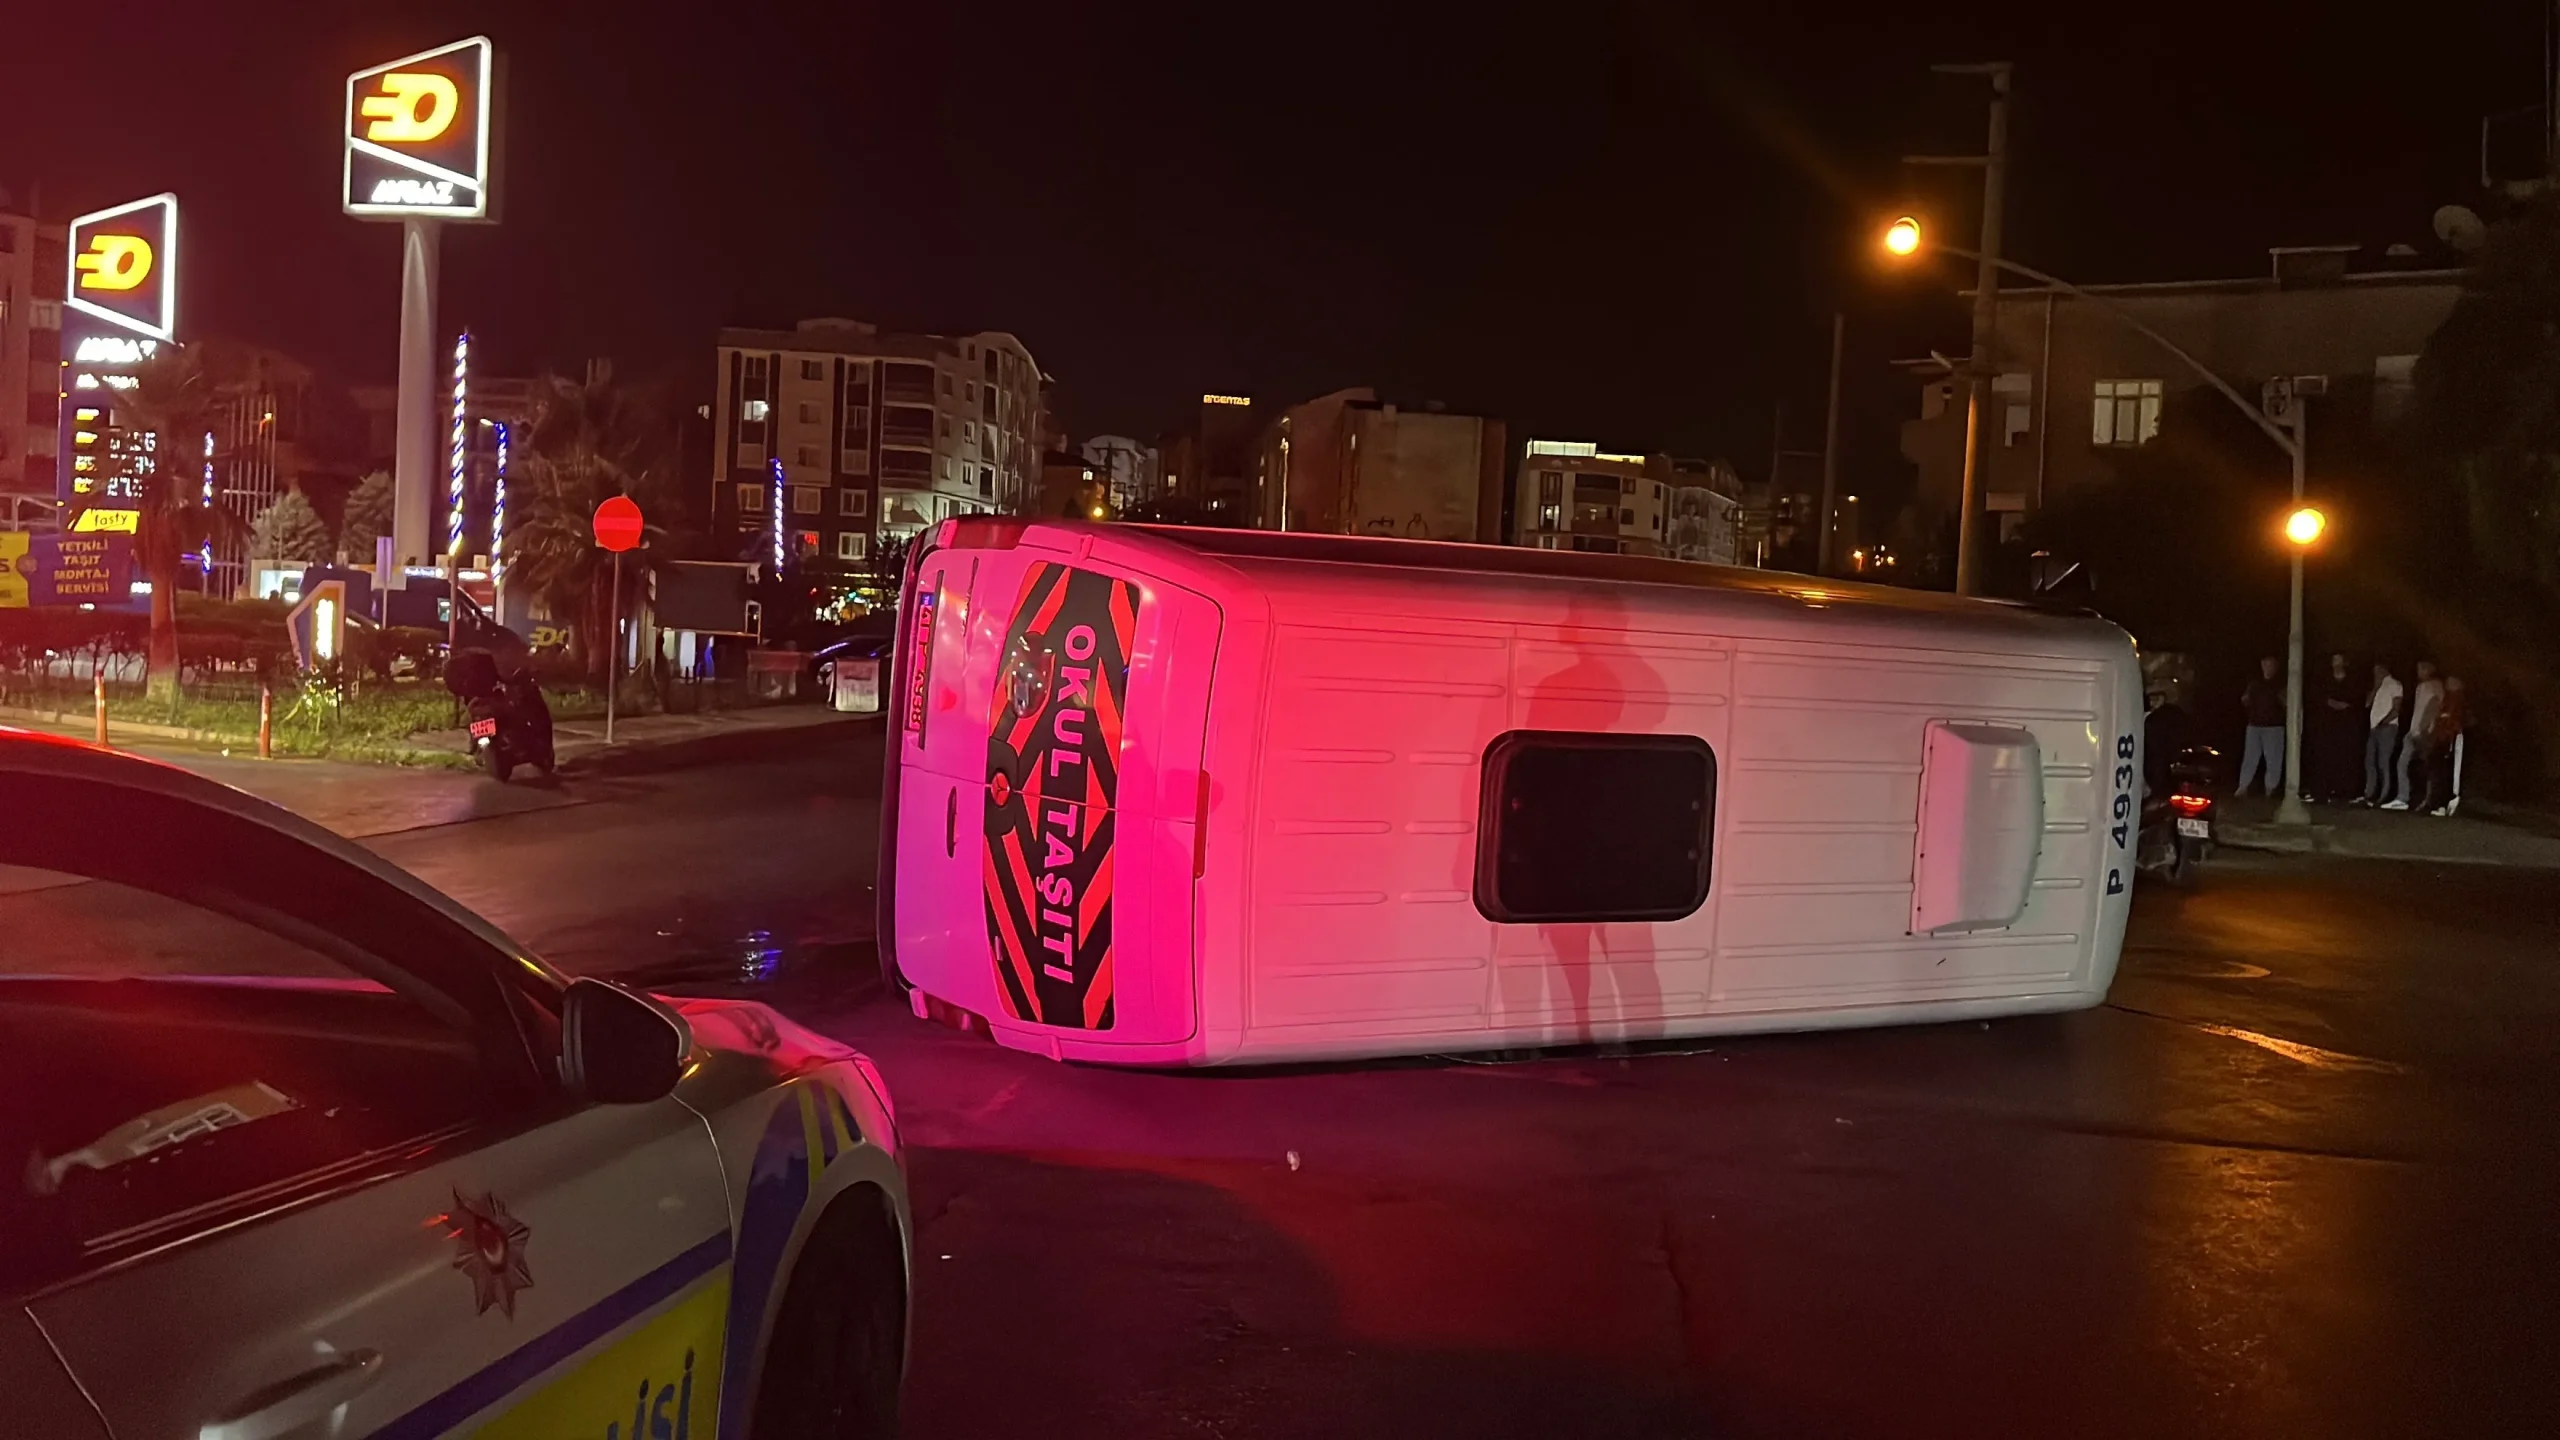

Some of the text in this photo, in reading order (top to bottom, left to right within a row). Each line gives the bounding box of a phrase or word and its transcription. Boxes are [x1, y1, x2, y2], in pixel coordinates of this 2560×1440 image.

[54, 568, 110, 581] MONTAJ
[1036, 624, 1096, 984] OKUL TAŞITI
[2106, 733, 2134, 896] P 4938
